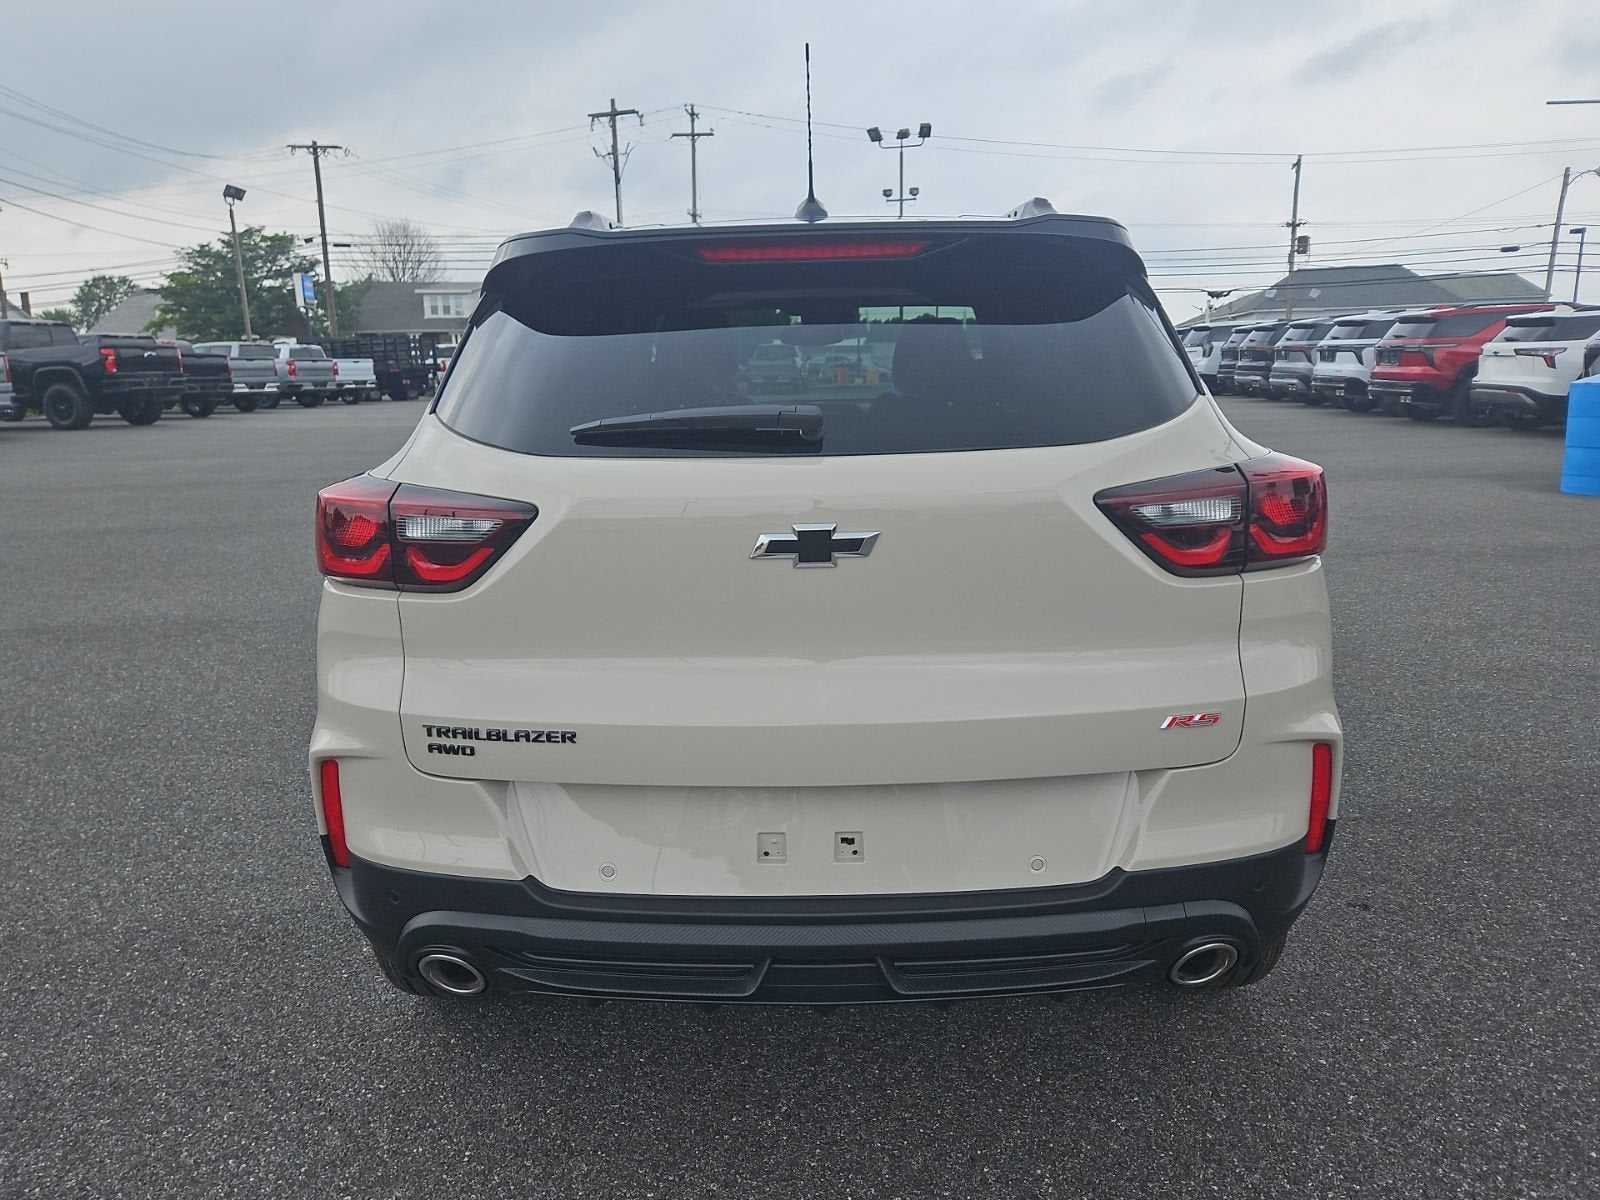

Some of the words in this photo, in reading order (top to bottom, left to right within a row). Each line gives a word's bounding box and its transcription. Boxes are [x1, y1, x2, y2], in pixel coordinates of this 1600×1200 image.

[1160, 712, 1221, 729] RS
[423, 725, 577, 744] TRAILBLAZER
[427, 743, 476, 757] AWD
